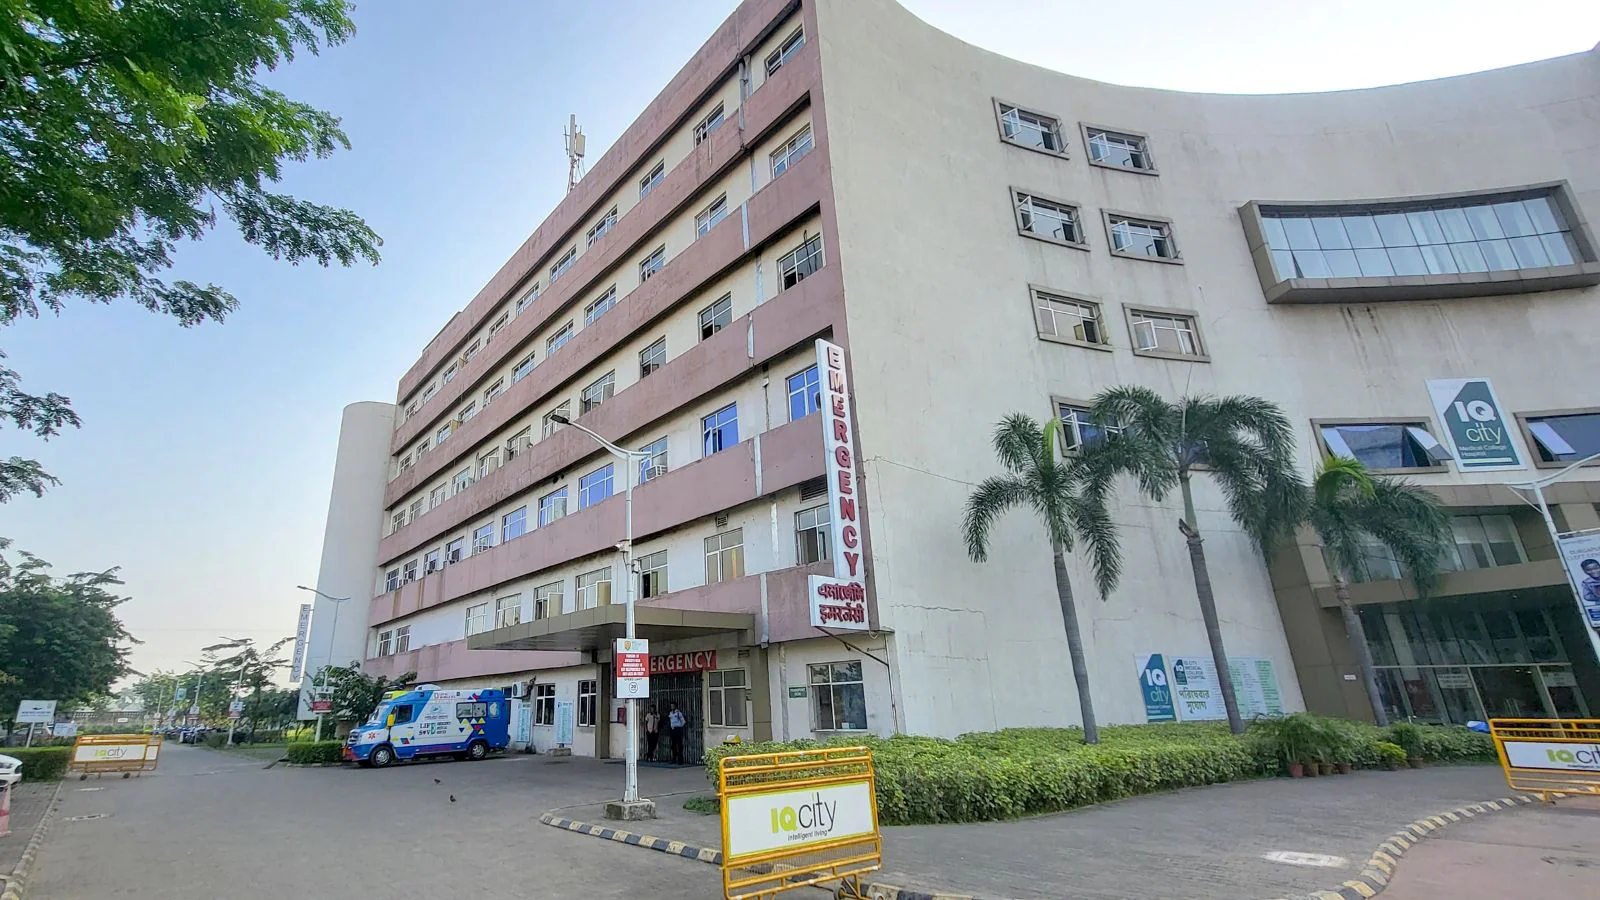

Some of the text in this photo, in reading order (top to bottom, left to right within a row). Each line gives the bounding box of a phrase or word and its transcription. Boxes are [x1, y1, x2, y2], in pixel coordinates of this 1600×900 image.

[1454, 400, 1497, 422] IQ
[1465, 422, 1501, 444] city
[826, 346, 860, 577] EMERGENCY
[293, 606, 310, 680] EMERGENCY
[650, 651, 713, 672] ERGENCY
[1145, 668, 1167, 686] IQ
[1150, 687, 1169, 704] city
[787, 829, 828, 841] intelligent living
